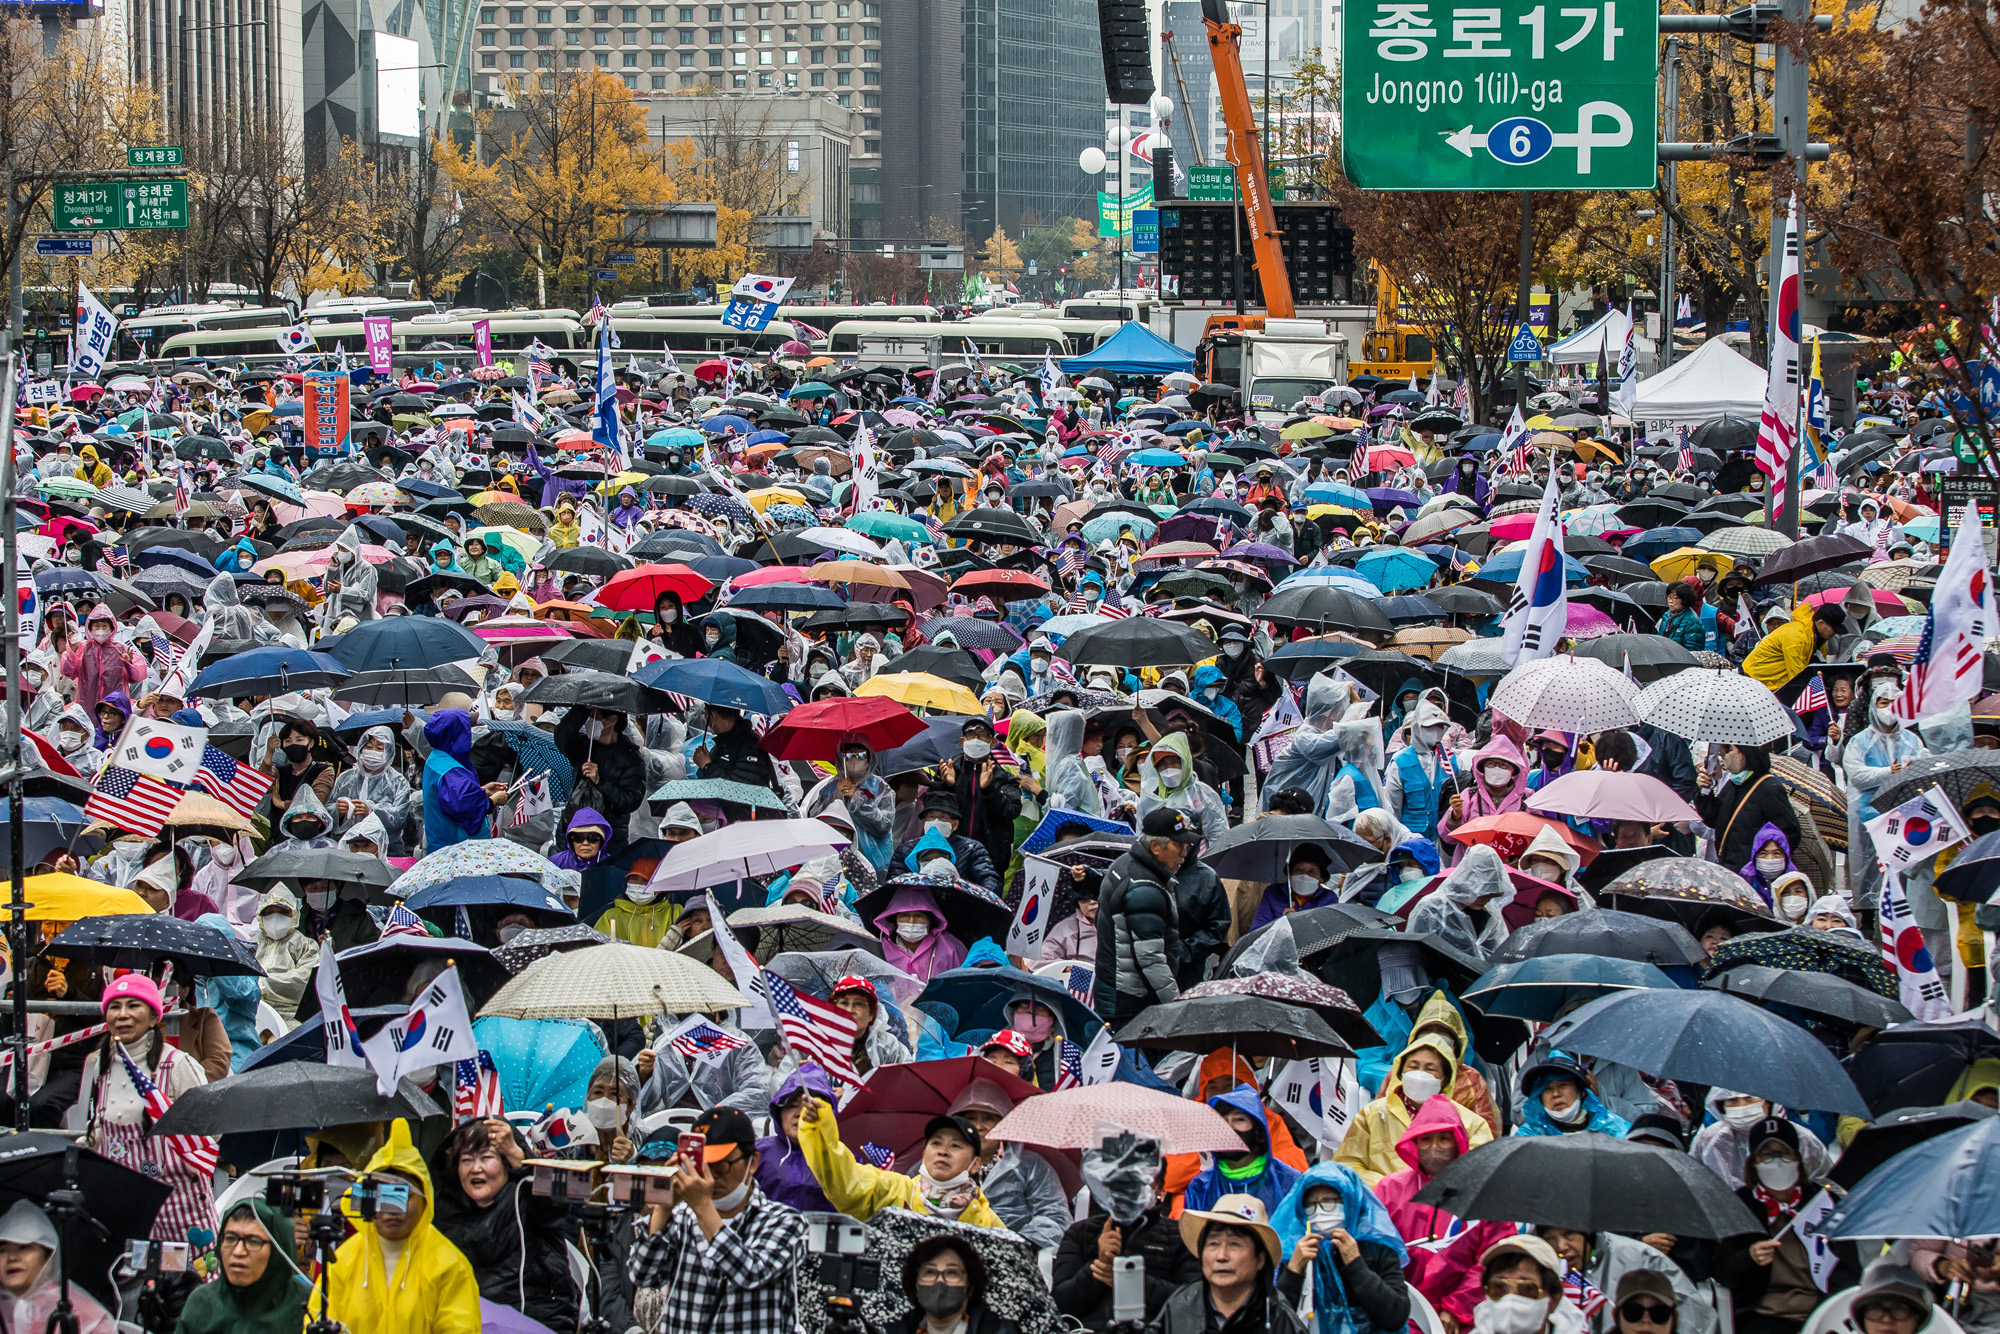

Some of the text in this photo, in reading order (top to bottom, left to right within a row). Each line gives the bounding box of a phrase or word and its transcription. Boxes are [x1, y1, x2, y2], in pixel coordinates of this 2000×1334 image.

[1369, 2, 1624, 61] 종로1가
[1366, 71, 1563, 112] Jongno 1(il)-ga
[1509, 125, 1531, 157] 6
[134, 151, 176, 162] 청계광장
[1190, 174, 1220, 183] 남산3호터널
[63, 190, 108, 204] 청계1가
[138, 184, 173, 197] 숭례문
[63, 205, 94, 215] Cheonggye
[140, 208, 161, 220] 시청
[140, 220, 153, 228] City
[30, 384, 58, 400] 전북
[1944, 481, 1993, 490] 광화문.광화문빌
[1765, 1120, 1778, 1133] D
